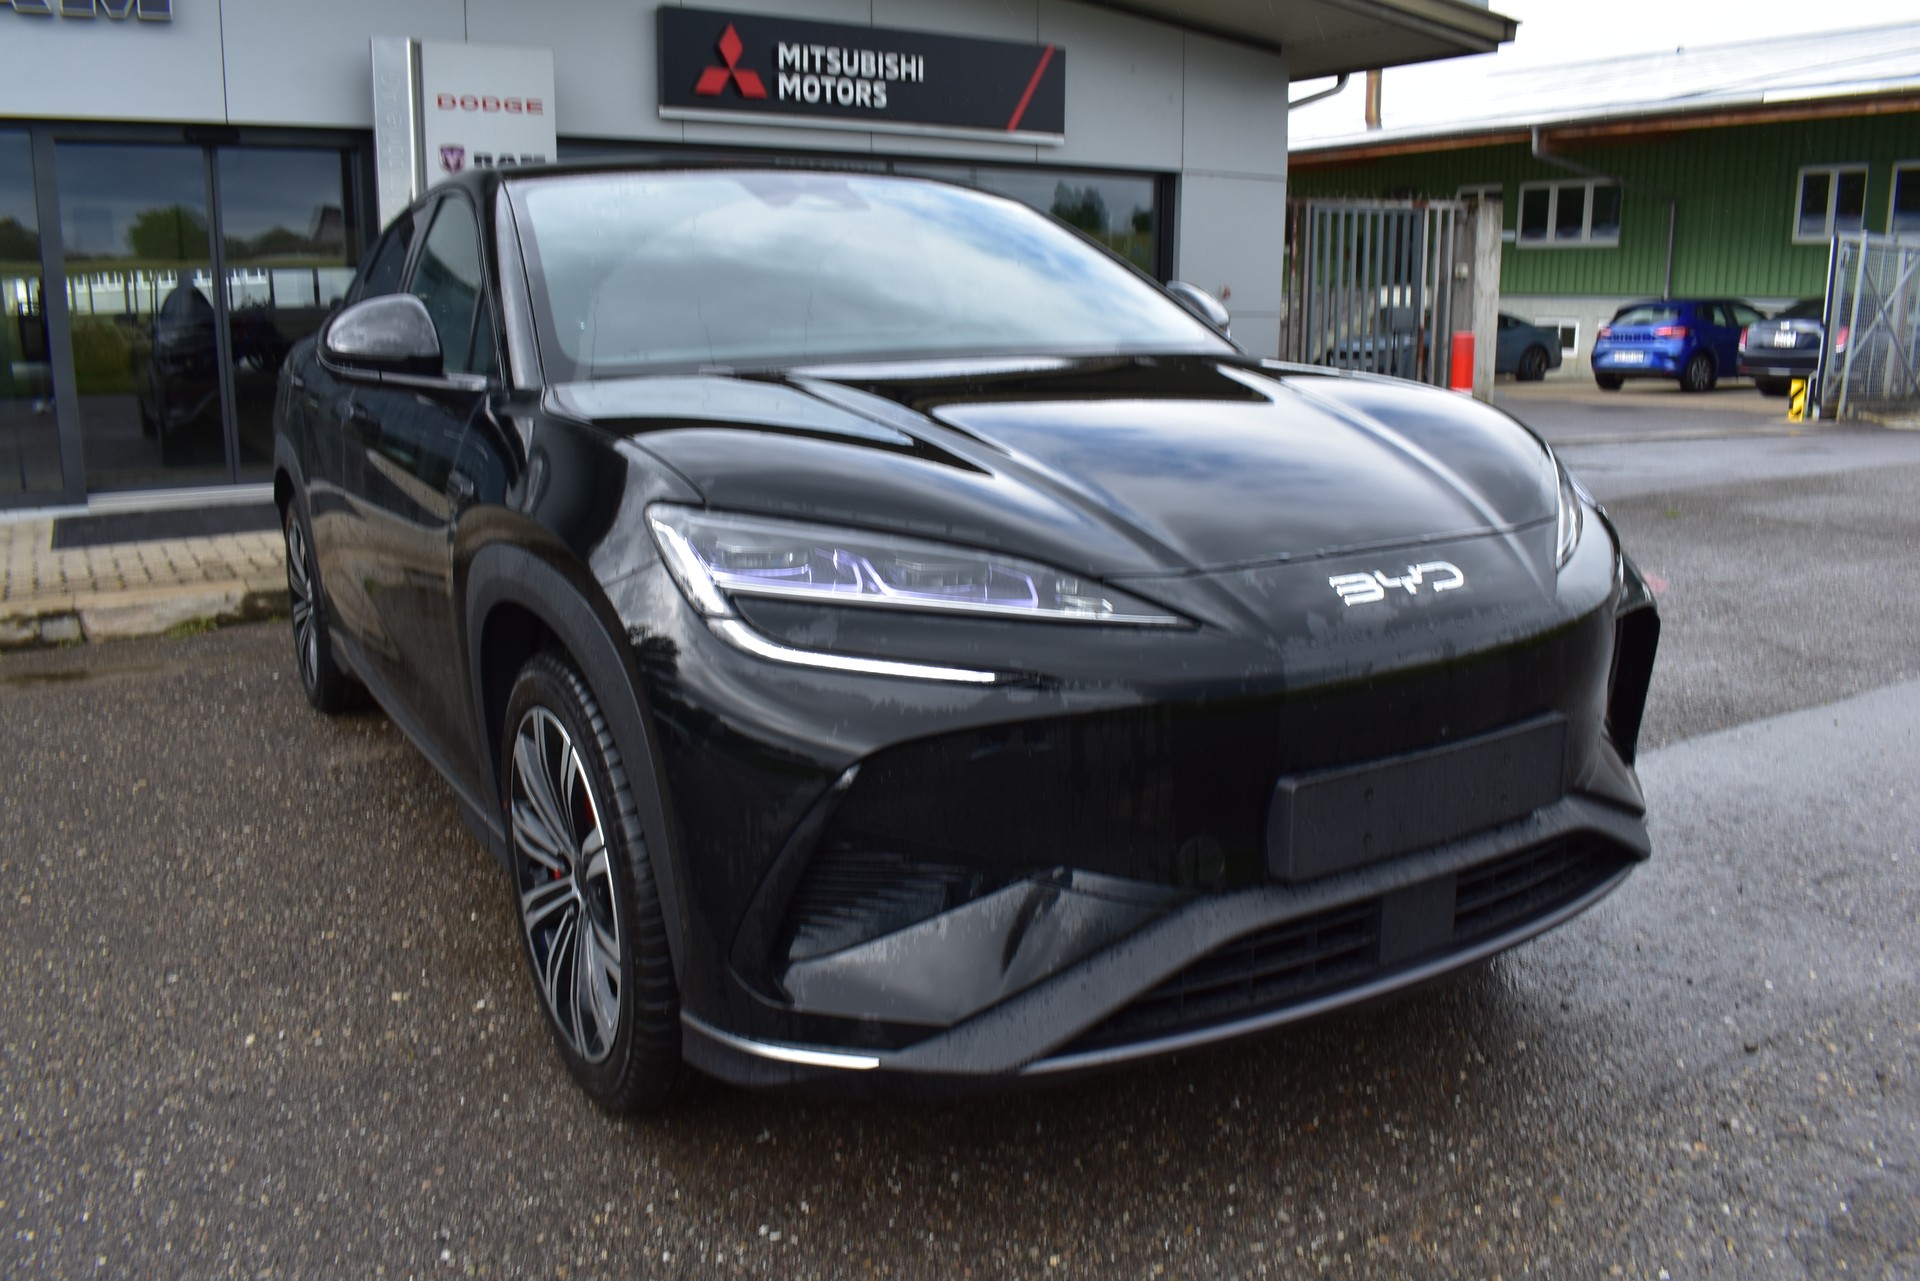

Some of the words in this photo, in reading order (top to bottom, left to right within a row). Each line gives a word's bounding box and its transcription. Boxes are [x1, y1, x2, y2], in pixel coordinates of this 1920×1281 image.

[778, 41, 924, 83] MITSUBISHI
[437, 93, 544, 116] DODGE
[778, 72, 887, 109] MOTORS
[1328, 560, 1465, 607] BYD
